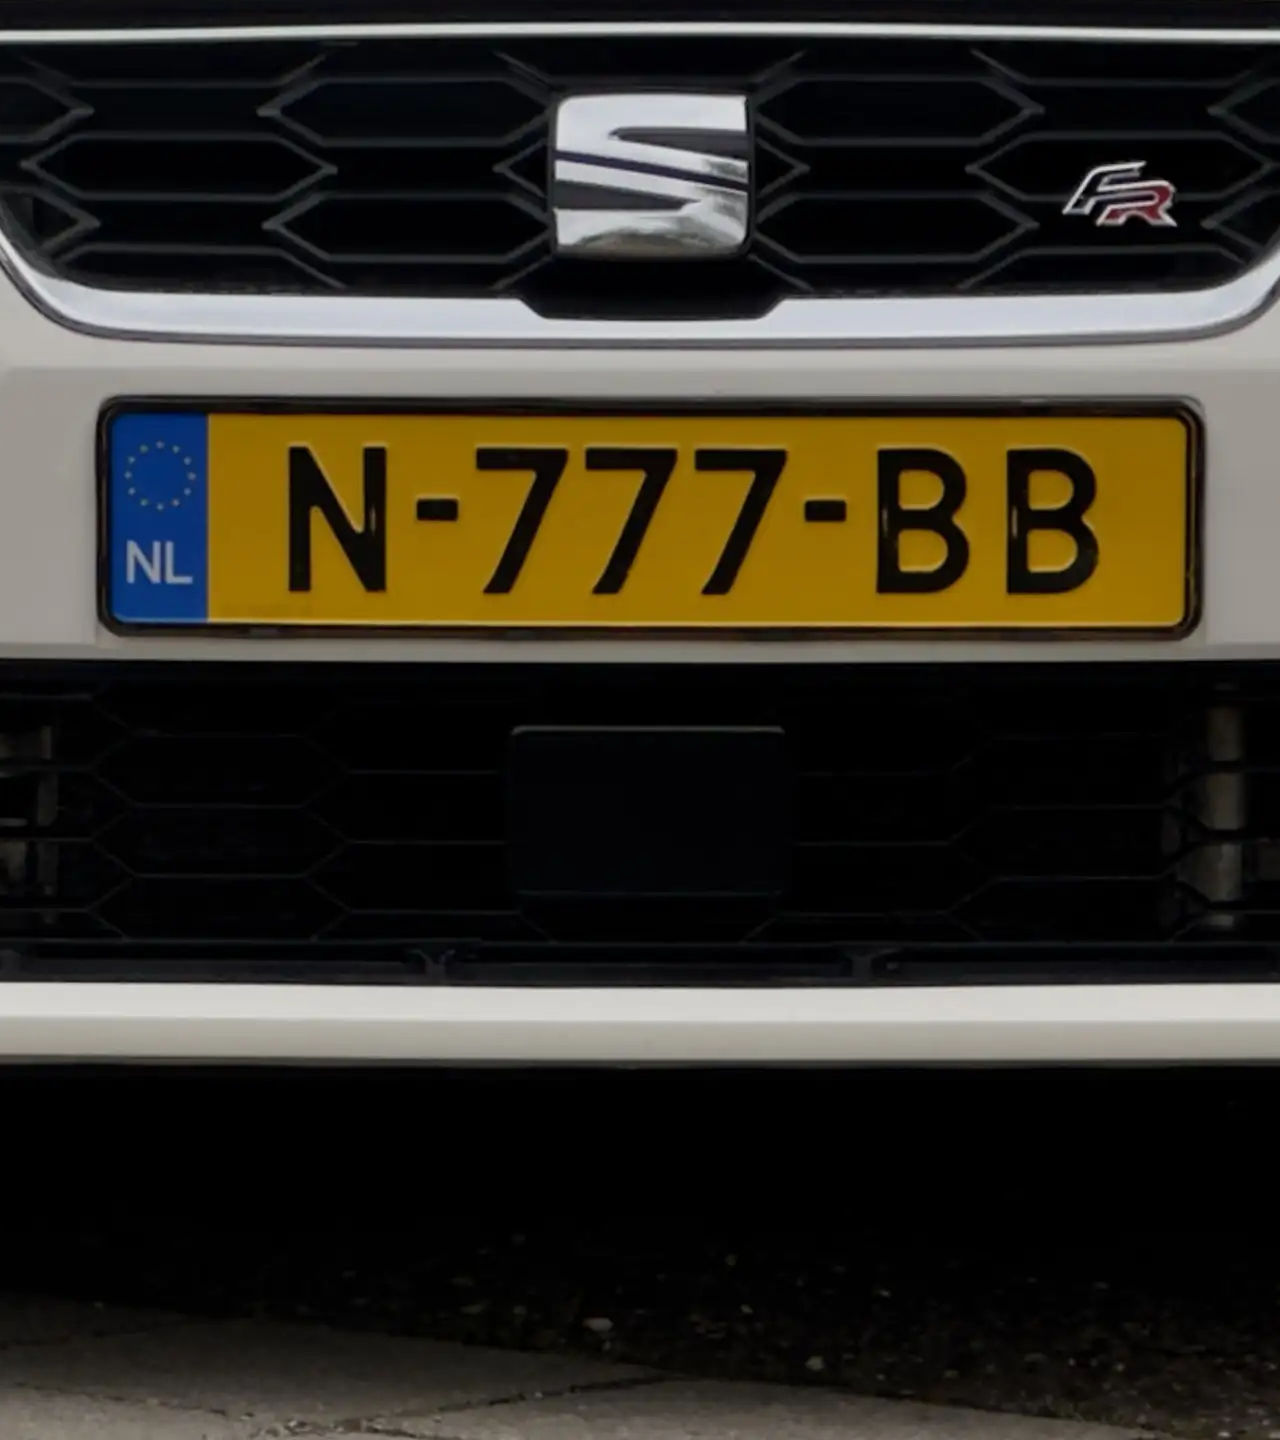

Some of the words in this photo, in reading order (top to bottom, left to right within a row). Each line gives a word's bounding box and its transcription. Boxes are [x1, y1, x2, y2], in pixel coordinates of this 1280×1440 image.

[1061, 160, 1178, 228] FR
[286, 444, 1101, 597] N-777-BB
[125, 538, 194, 585] NL
